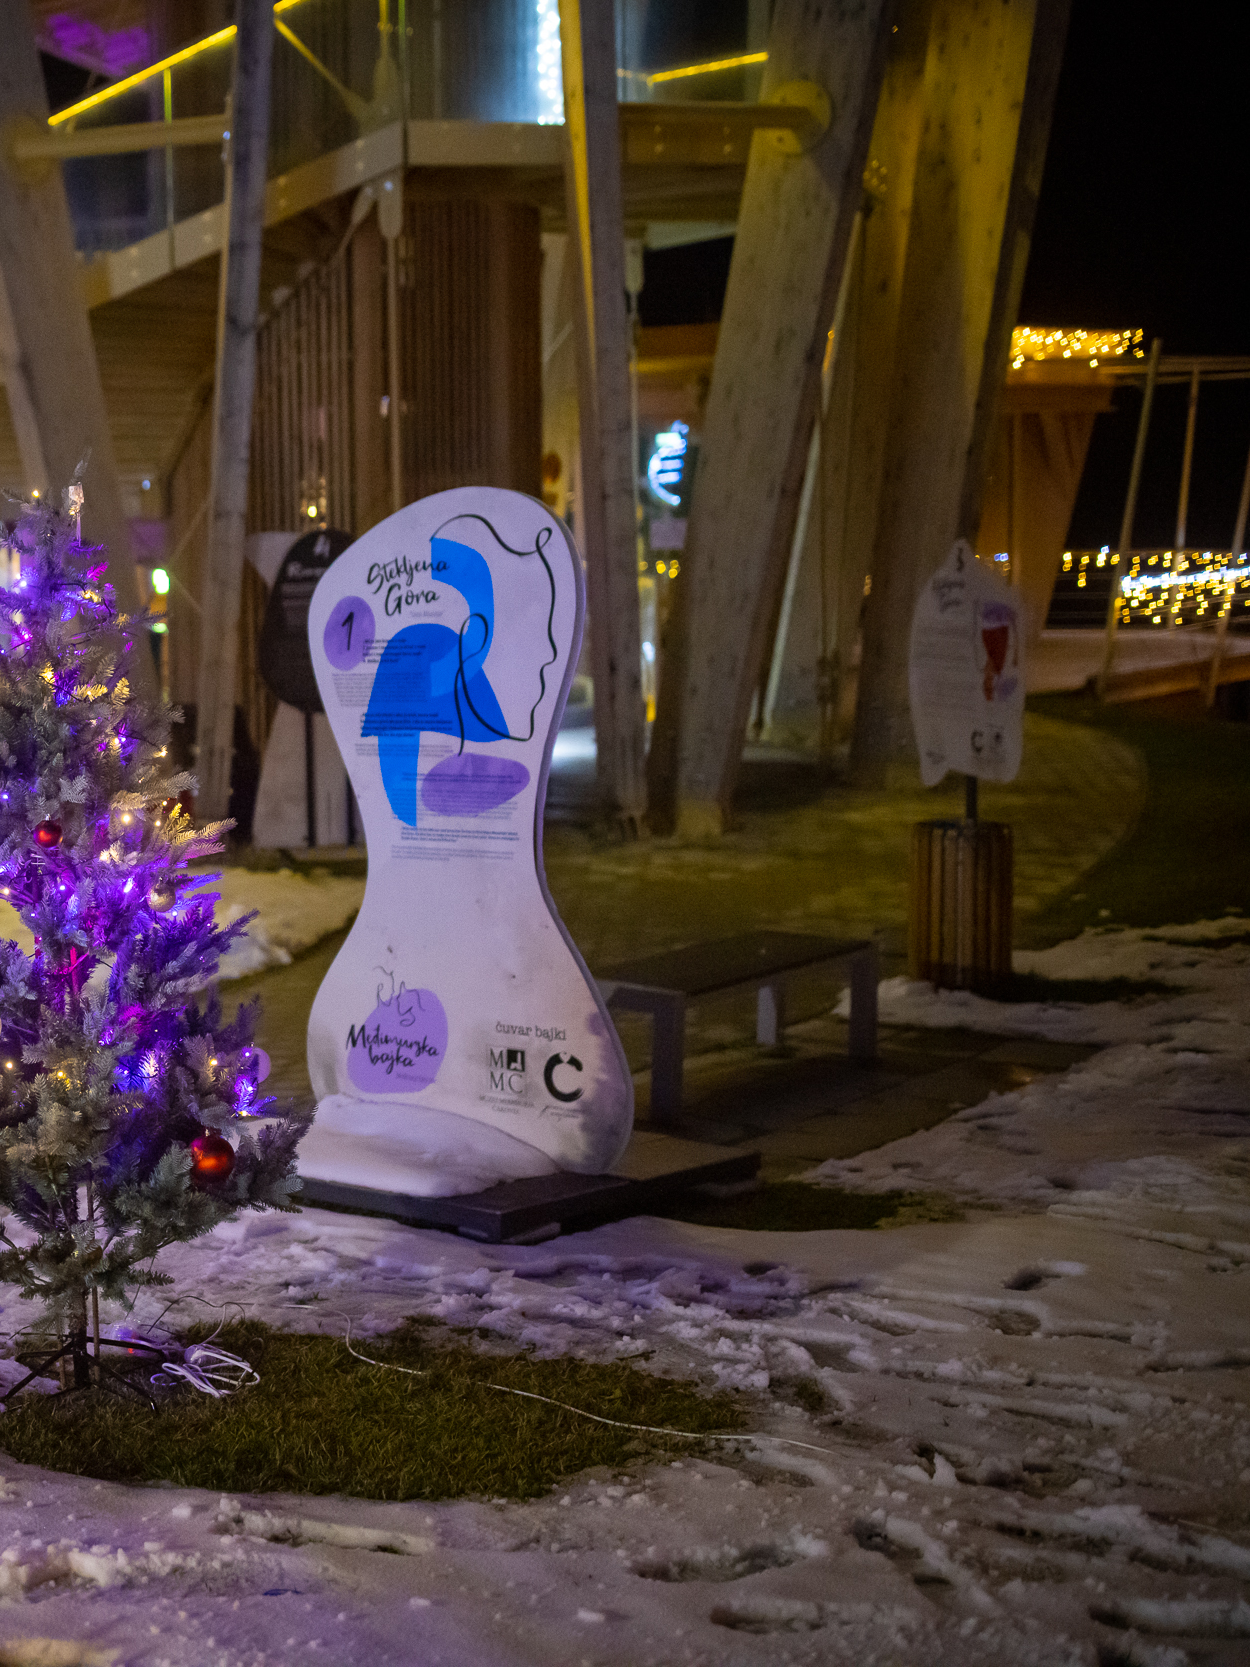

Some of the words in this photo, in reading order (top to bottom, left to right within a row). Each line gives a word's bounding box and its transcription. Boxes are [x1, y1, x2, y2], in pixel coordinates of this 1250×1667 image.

[366, 554, 451, 595] Stekljena
[384, 583, 440, 617] Gora
[341, 611, 355, 651] 1
[496, 1021, 533, 1038] čuvar
[534, 1027, 568, 1042] bajki
[368, 1045, 415, 1075] bajka
